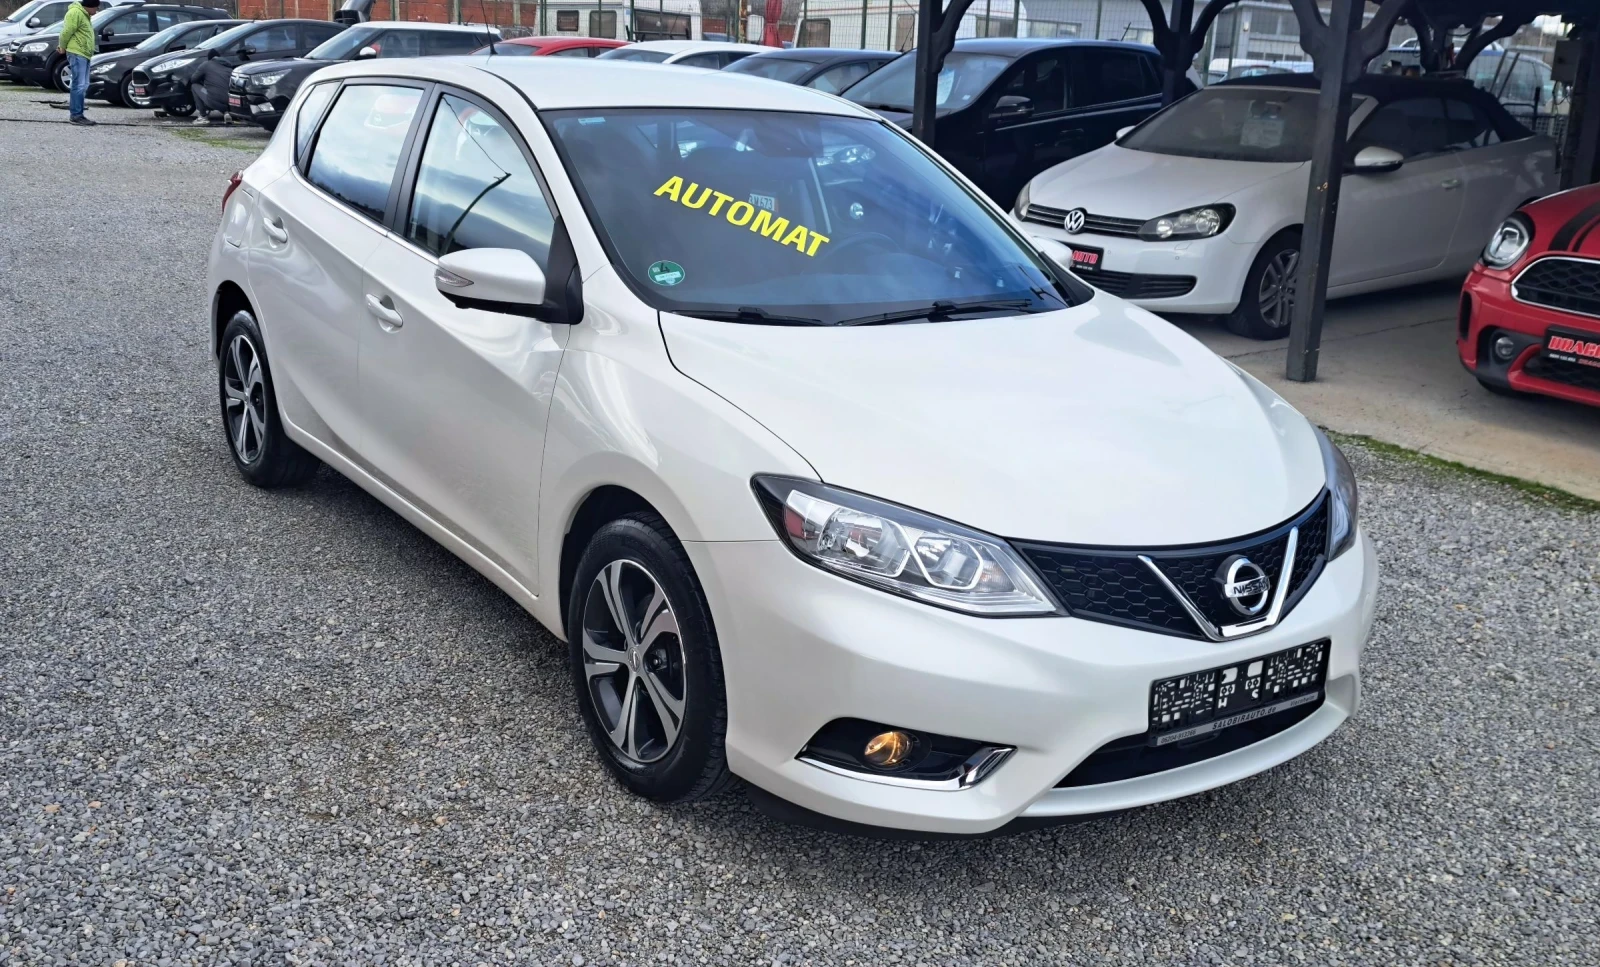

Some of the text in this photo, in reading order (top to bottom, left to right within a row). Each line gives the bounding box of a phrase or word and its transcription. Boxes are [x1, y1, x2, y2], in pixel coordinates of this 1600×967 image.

[653, 175, 830, 257] AUTOMAT
[1064, 210, 1085, 233] VW
[660, 262, 670, 272] 4
[1233, 577, 1268, 595] NISSAN
[1212, 706, 1277, 730] SALOBIRAUTO.de
